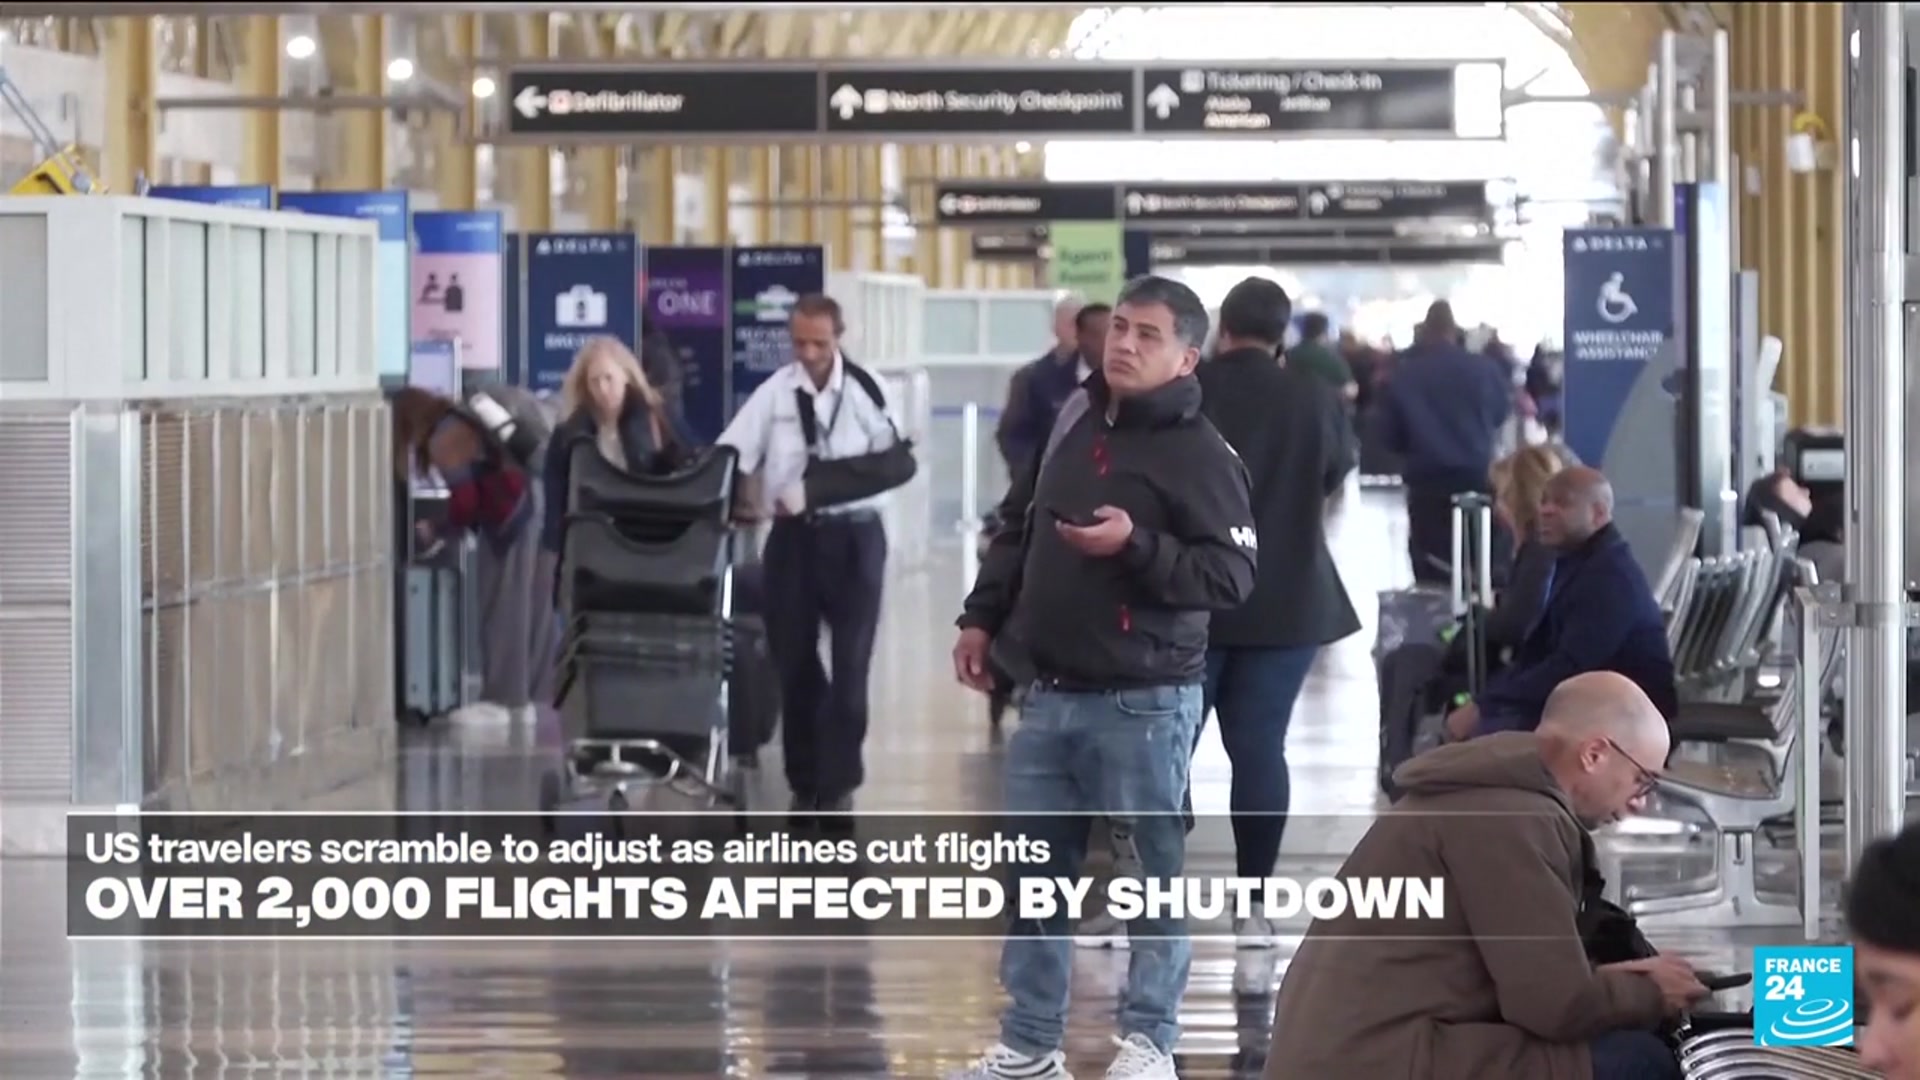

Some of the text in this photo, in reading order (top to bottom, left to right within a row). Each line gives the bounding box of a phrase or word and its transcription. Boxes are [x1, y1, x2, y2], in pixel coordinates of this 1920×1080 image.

[945, 90, 1017, 114] Security
[1019, 90, 1123, 113] Checkpoint
[553, 239, 612, 254] DELTA
[1589, 236, 1648, 250] DELTA
[657, 290, 717, 316] ONE
[1573, 330, 1663, 344] WHEELCHAIR
